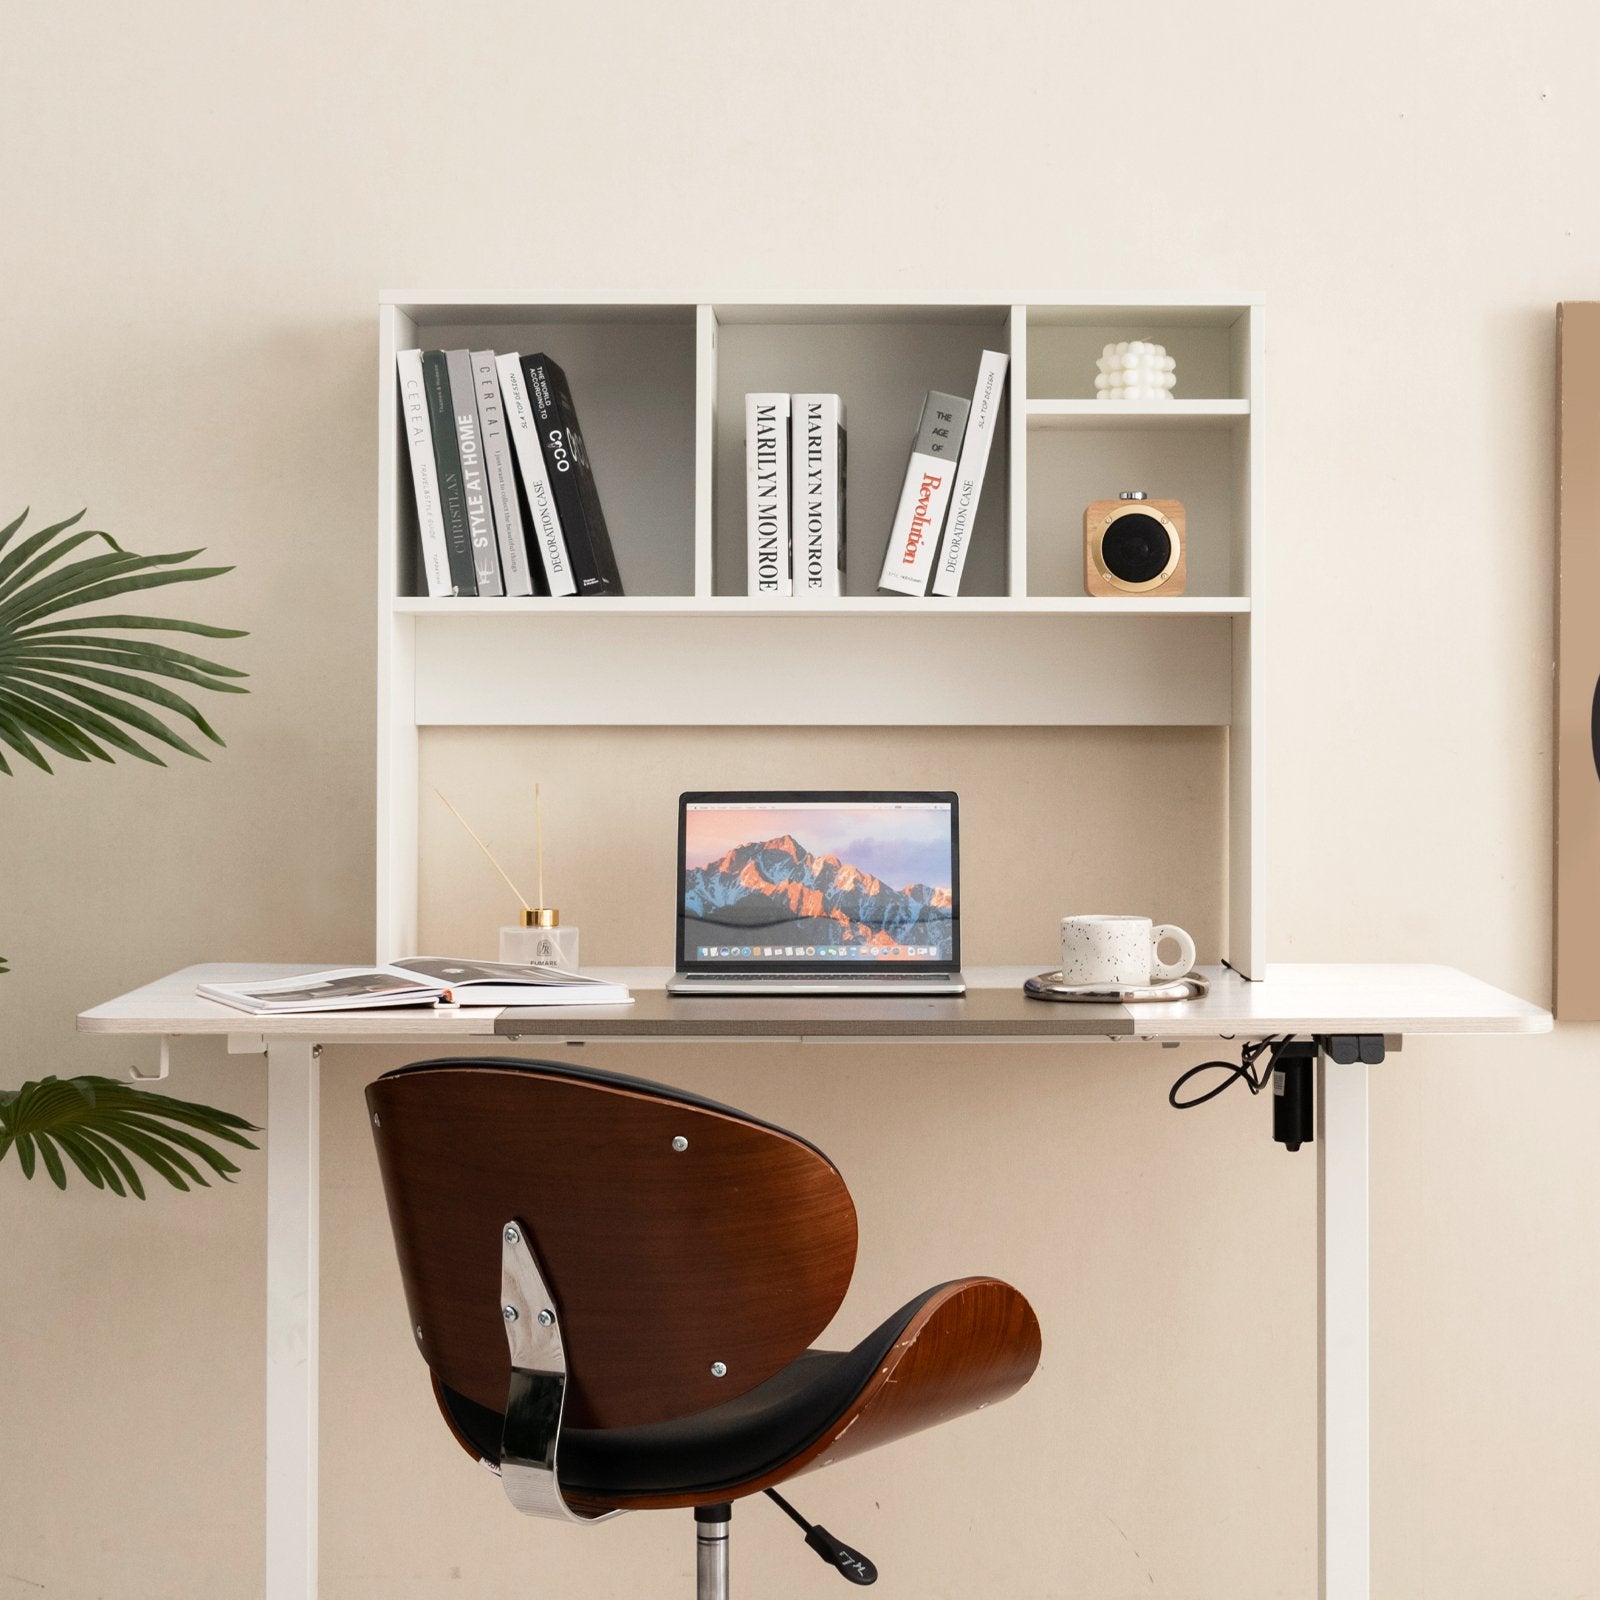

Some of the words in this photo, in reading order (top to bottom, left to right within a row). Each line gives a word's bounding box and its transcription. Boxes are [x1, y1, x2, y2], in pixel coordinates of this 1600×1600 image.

[480, 366, 500, 438] CEREAL
[510, 373, 520, 399] DESIGN
[530, 368, 544, 408] ACCORDING
[540, 409, 548, 419] TO
[541, 381, 551, 406] WORLD
[984, 372, 994, 399] DESIGN
[406, 380, 425, 446] CEREAL
[932, 428, 949, 438] AGE
[936, 411, 952, 422] THE
[458, 414, 478, 464] HOME
[548, 429, 570, 472] CCO
[756, 405, 777, 499] MARILYN
[808, 403, 822, 496] MARILYN
[931, 443, 944, 453] OF
[464, 469, 481, 490] AT
[533, 480, 548, 506] CASE
[468, 495, 489, 547] STYLE
[506, 524, 515, 551] beautiful
[540, 507, 564, 572] DECORATION
[808, 499, 823, 588] MONROE
[902, 472, 942, 565] Revolution
[944, 507, 969, 573] DECORATION
[958, 479, 974, 506] CASE
[758, 504, 779, 592] MONROE
